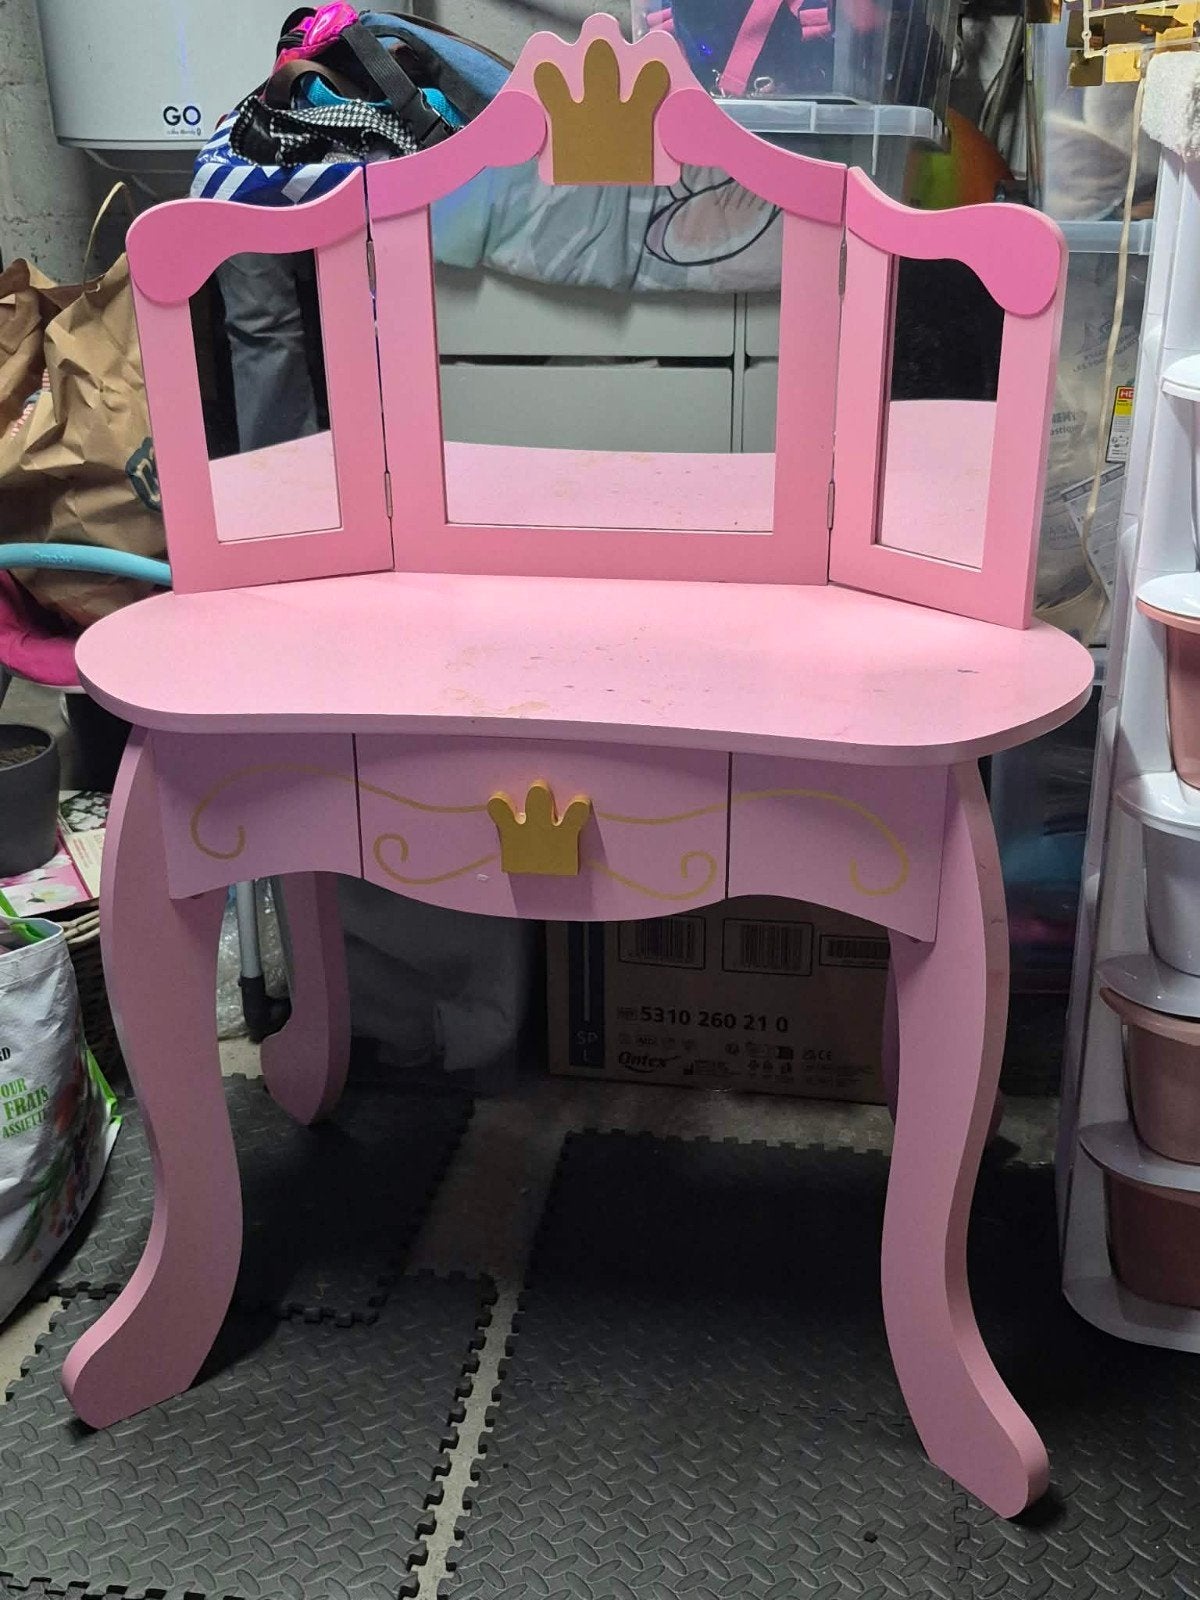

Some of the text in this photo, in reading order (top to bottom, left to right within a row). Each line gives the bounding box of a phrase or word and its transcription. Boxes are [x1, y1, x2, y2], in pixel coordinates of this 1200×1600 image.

[163, 105, 201, 126] GO
[641, 1006, 691, 1025] 5310
[697, 1010, 737, 1029] 260
[743, 1013, 767, 1031] 21
[776, 1016, 789, 1032] 0
[3, 1085, 49, 1121] FRAIS
